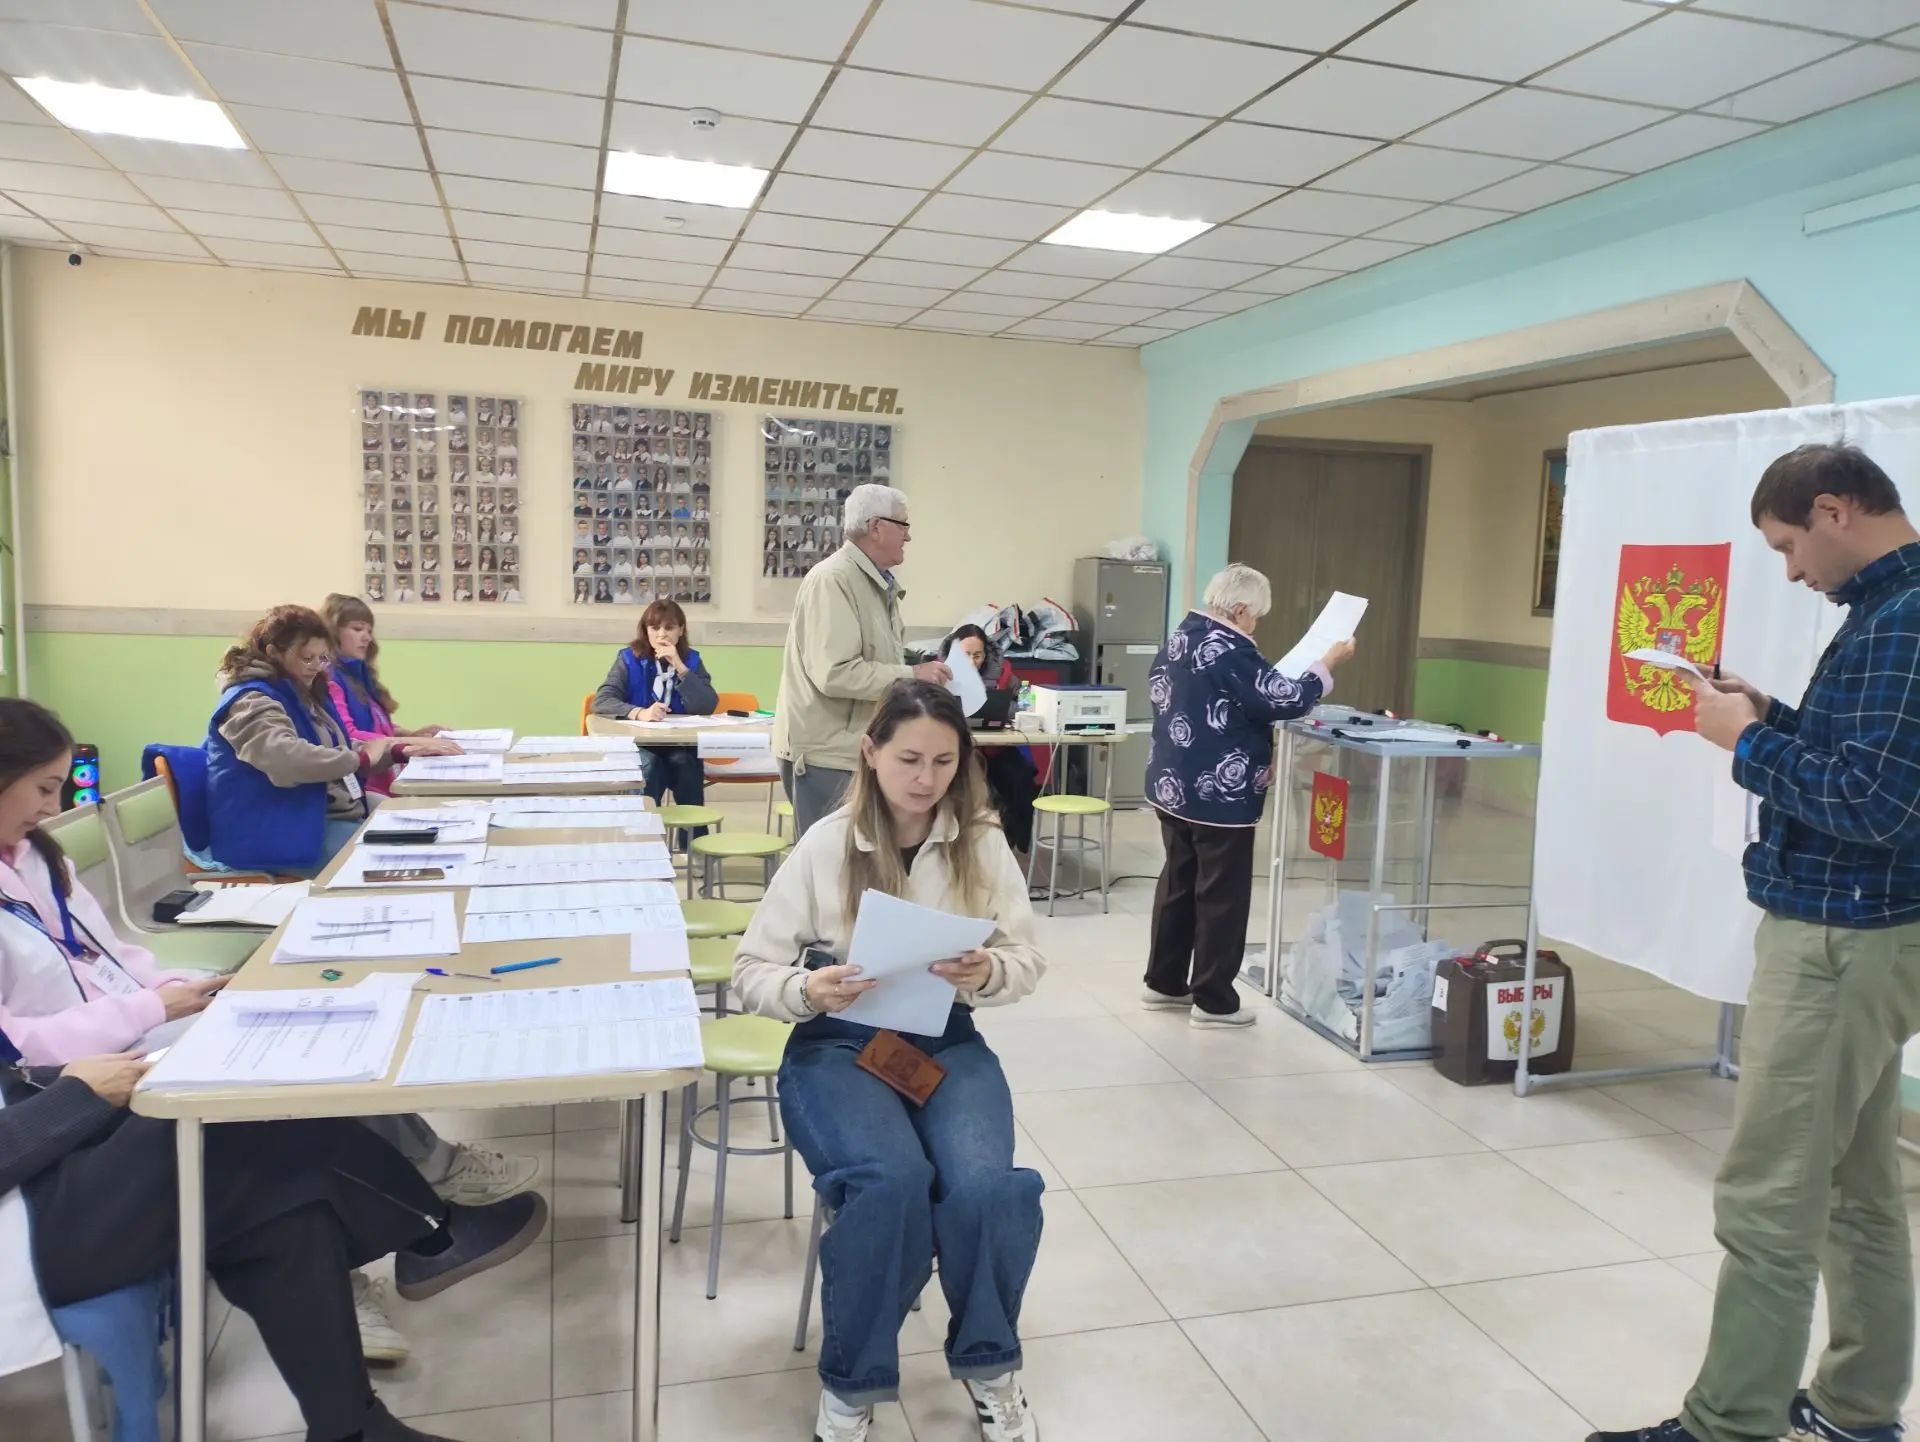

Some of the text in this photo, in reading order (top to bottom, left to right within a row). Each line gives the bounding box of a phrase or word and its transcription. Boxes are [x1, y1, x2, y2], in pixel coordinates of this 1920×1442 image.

[352, 307, 643, 359] МЫ ПОМОГАЕМ
[574, 362, 904, 415] МИРУ ИЗМЕНИТЬСЯ.
[1497, 984, 1553, 1004] ВЫБРЫ
